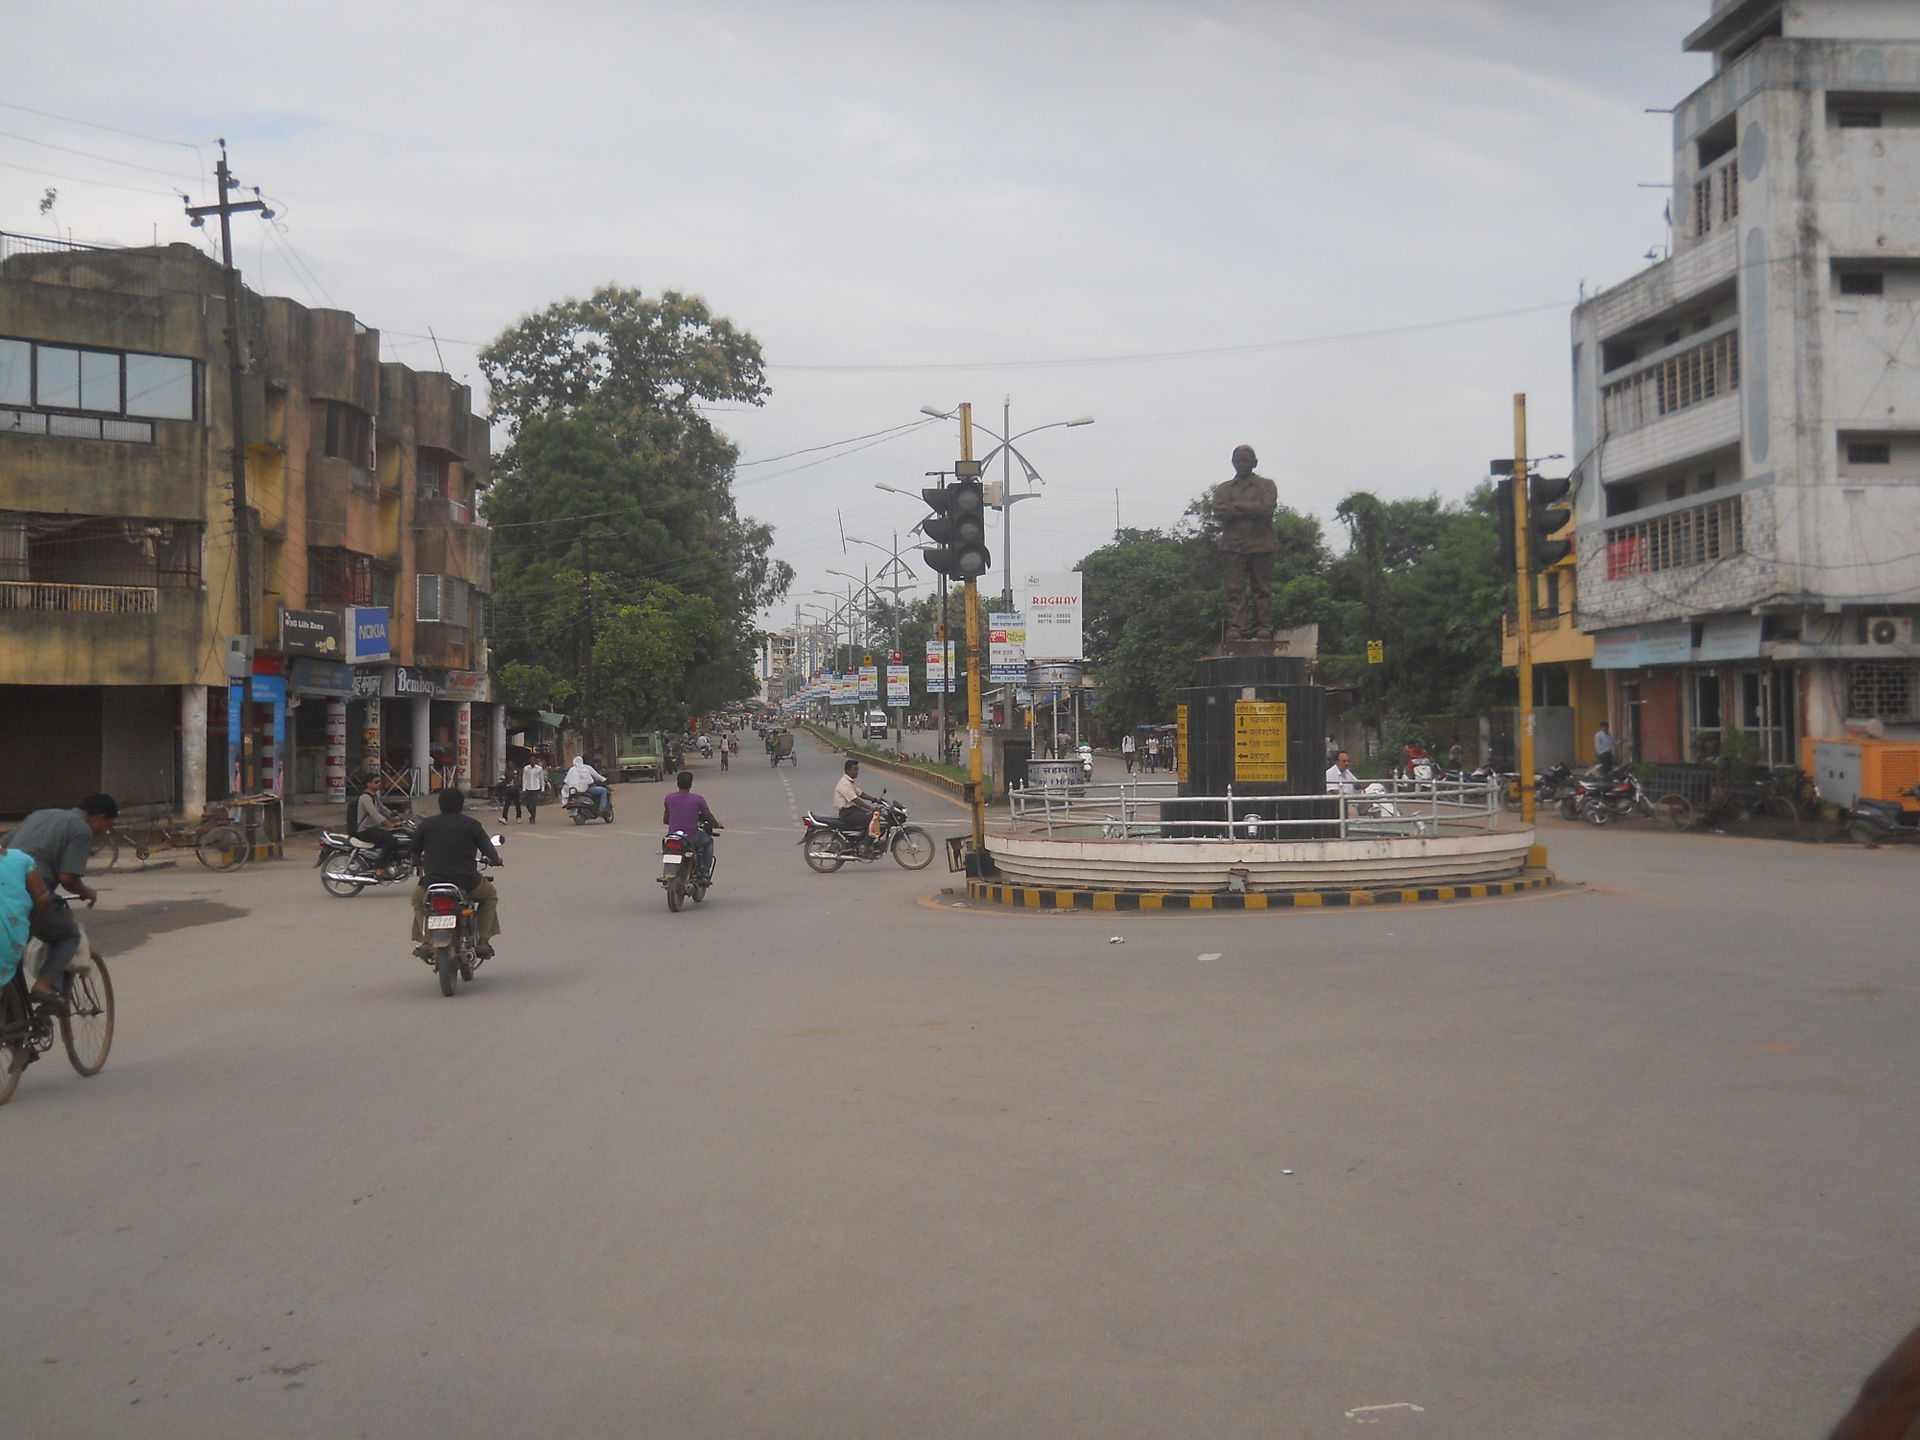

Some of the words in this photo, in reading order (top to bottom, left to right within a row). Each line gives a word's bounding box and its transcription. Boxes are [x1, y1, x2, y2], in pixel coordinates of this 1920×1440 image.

[1032, 596, 1078, 605] RAGHAV
[298, 620, 310, 629] Life
[310, 621, 324, 631] Zone
[359, 623, 386, 640] NOKIA
[398, 667, 435, 696] Bombay
[1042, 766, 1077, 774] सहायता
